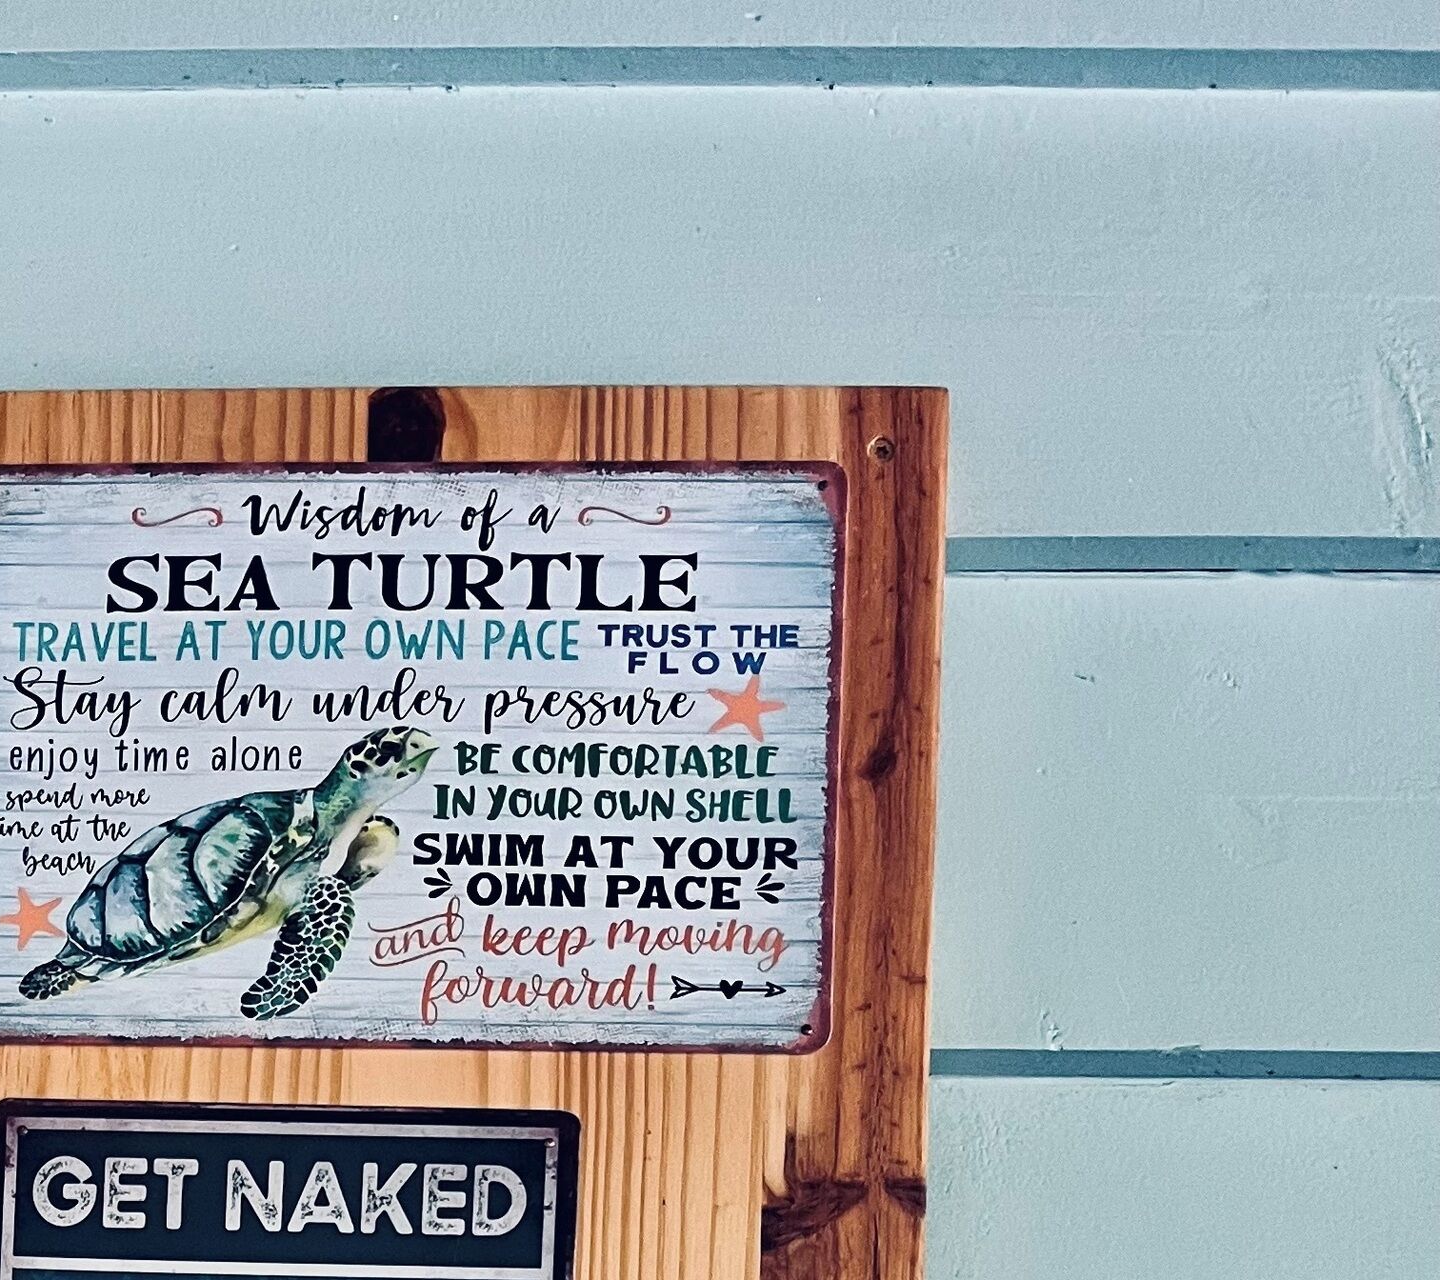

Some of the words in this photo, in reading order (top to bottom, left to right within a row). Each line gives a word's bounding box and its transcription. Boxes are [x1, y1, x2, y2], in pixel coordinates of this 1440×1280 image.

[242, 487, 442, 539] Wisdom
[460, 489, 512, 551] of
[529, 504, 561, 533] a
[106, 553, 280, 613] SEA
[312, 552, 698, 612] TURTLE
[13, 622, 157, 661] TRAVEL
[176, 621, 226, 661] AT
[247, 620, 346, 661] YOUR
[365, 620, 464, 661] OWN
[484, 620, 579, 661] PACE
[598, 624, 716, 648] TRUST
[731, 625, 799, 648] THE
[629, 651, 766, 675] FLOW
[3, 667, 140, 737] Stay
[160, 667, 292, 723] calm
[313, 667, 465, 723] under
[484, 685, 695, 734] pressure
[10, 739, 98, 780] enjoy
[115, 739, 189, 771] time
[212, 736, 302, 770] alone
[454, 741, 502, 775] BE
[512, 743, 779, 778] COMFORTABLE
[5, 783, 83, 810] spend
[91, 787, 150, 806] more
[433, 784, 476, 820] IN
[487, 784, 582, 821] YOUR
[594, 787, 675, 822] OWN
[686, 788, 797, 824] SHELL
[51, 818, 78, 841] at
[87, 814, 131, 839] the
[22, 847, 97, 876] beach
[412, 833, 544, 867] SWIM
[564, 836, 633, 868] AT
[655, 836, 798, 870] YOUR
[467, 871, 586, 908] OWN
[606, 875, 741, 910] PACE
[368, 896, 466, 965] and
[482, 914, 595, 967] keep
[608, 919, 788, 971] moving
[421, 959, 656, 1026] forward!
[32, 1155, 199, 1230] GET
[225, 1160, 527, 1237] NAKED
